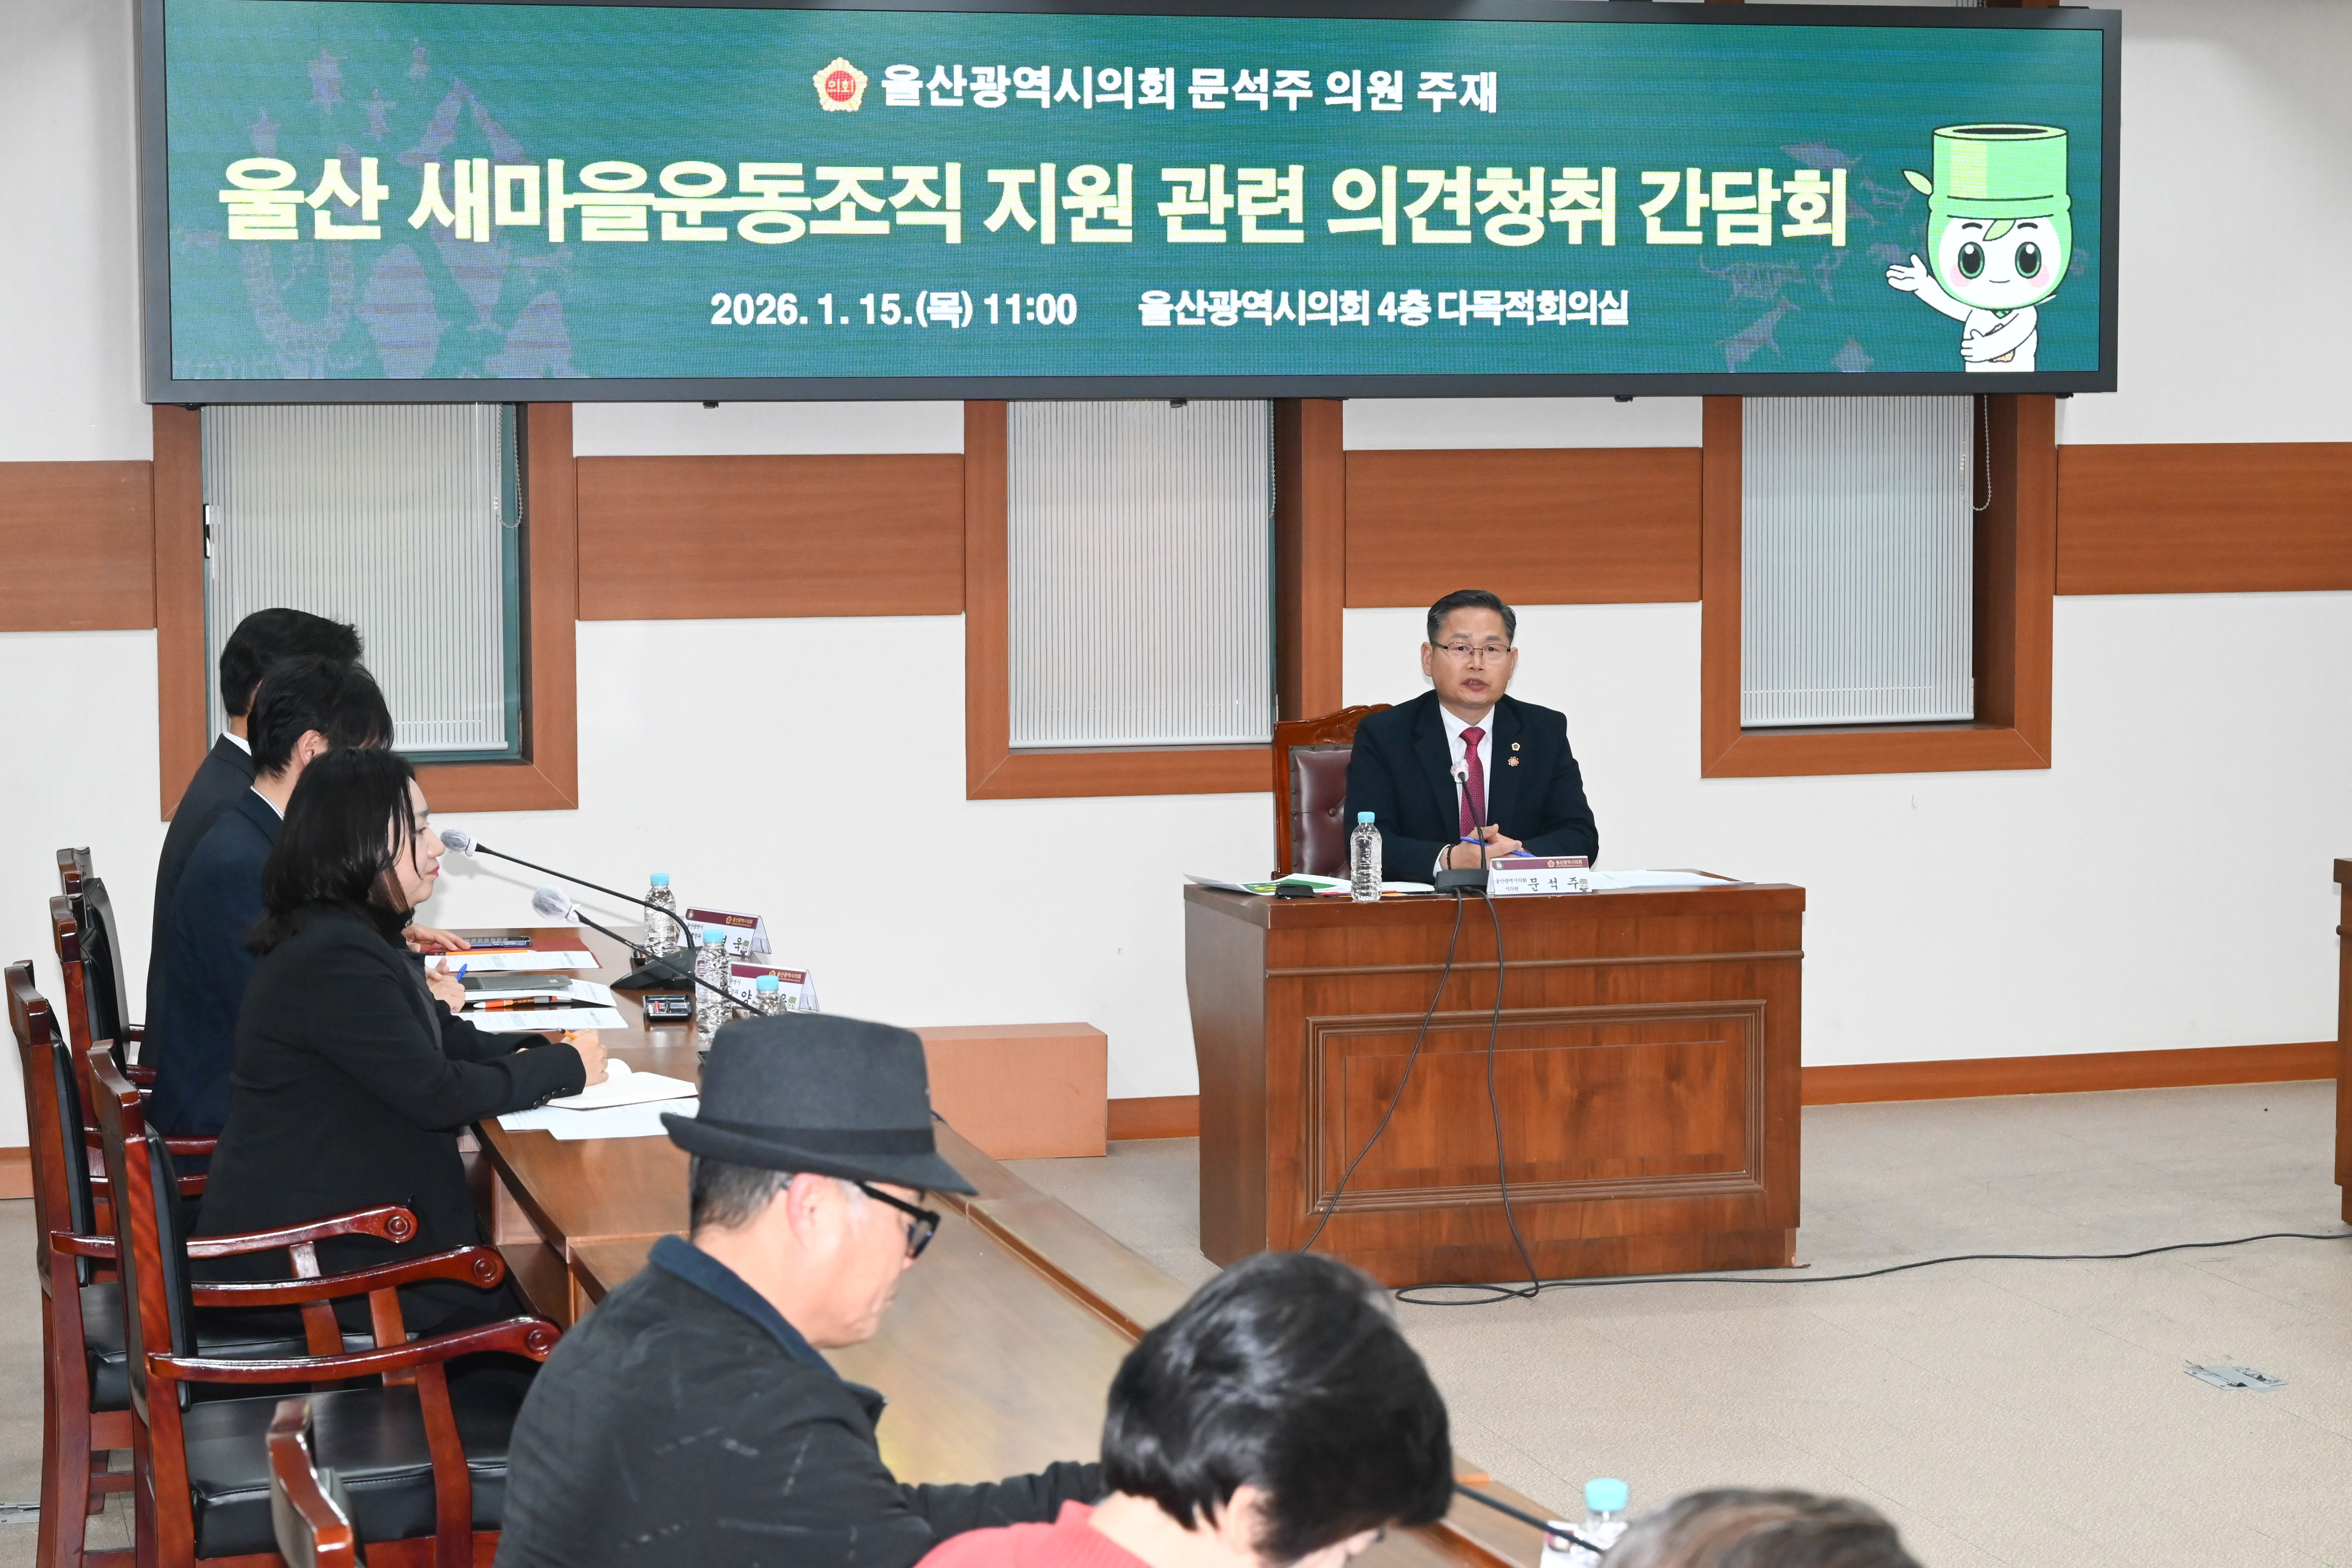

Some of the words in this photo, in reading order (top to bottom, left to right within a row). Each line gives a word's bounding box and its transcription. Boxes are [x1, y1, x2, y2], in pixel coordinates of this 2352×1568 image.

[882, 65, 1174, 109] 울산광역시의회
[1189, 69, 1312, 110] 문석주
[1325, 70, 1402, 111] 의원
[1418, 72, 1496, 113] 주재
[219, 157, 389, 240] 울산
[408, 159, 961, 243] 새마을운동조직
[984, 163, 1133, 243] 지원
[1158, 165, 1304, 242] 관련
[1328, 166, 1615, 246] 의견청취
[1640, 168, 1846, 246] 간담회
[711, 293, 807, 324] 2026.
[984, 294, 1076, 324] 11:00
[1139, 290, 1369, 326] 울산광역시의회
[1378, 290, 1431, 326] 4층
[1439, 290, 1628, 325] 다목적회의실
